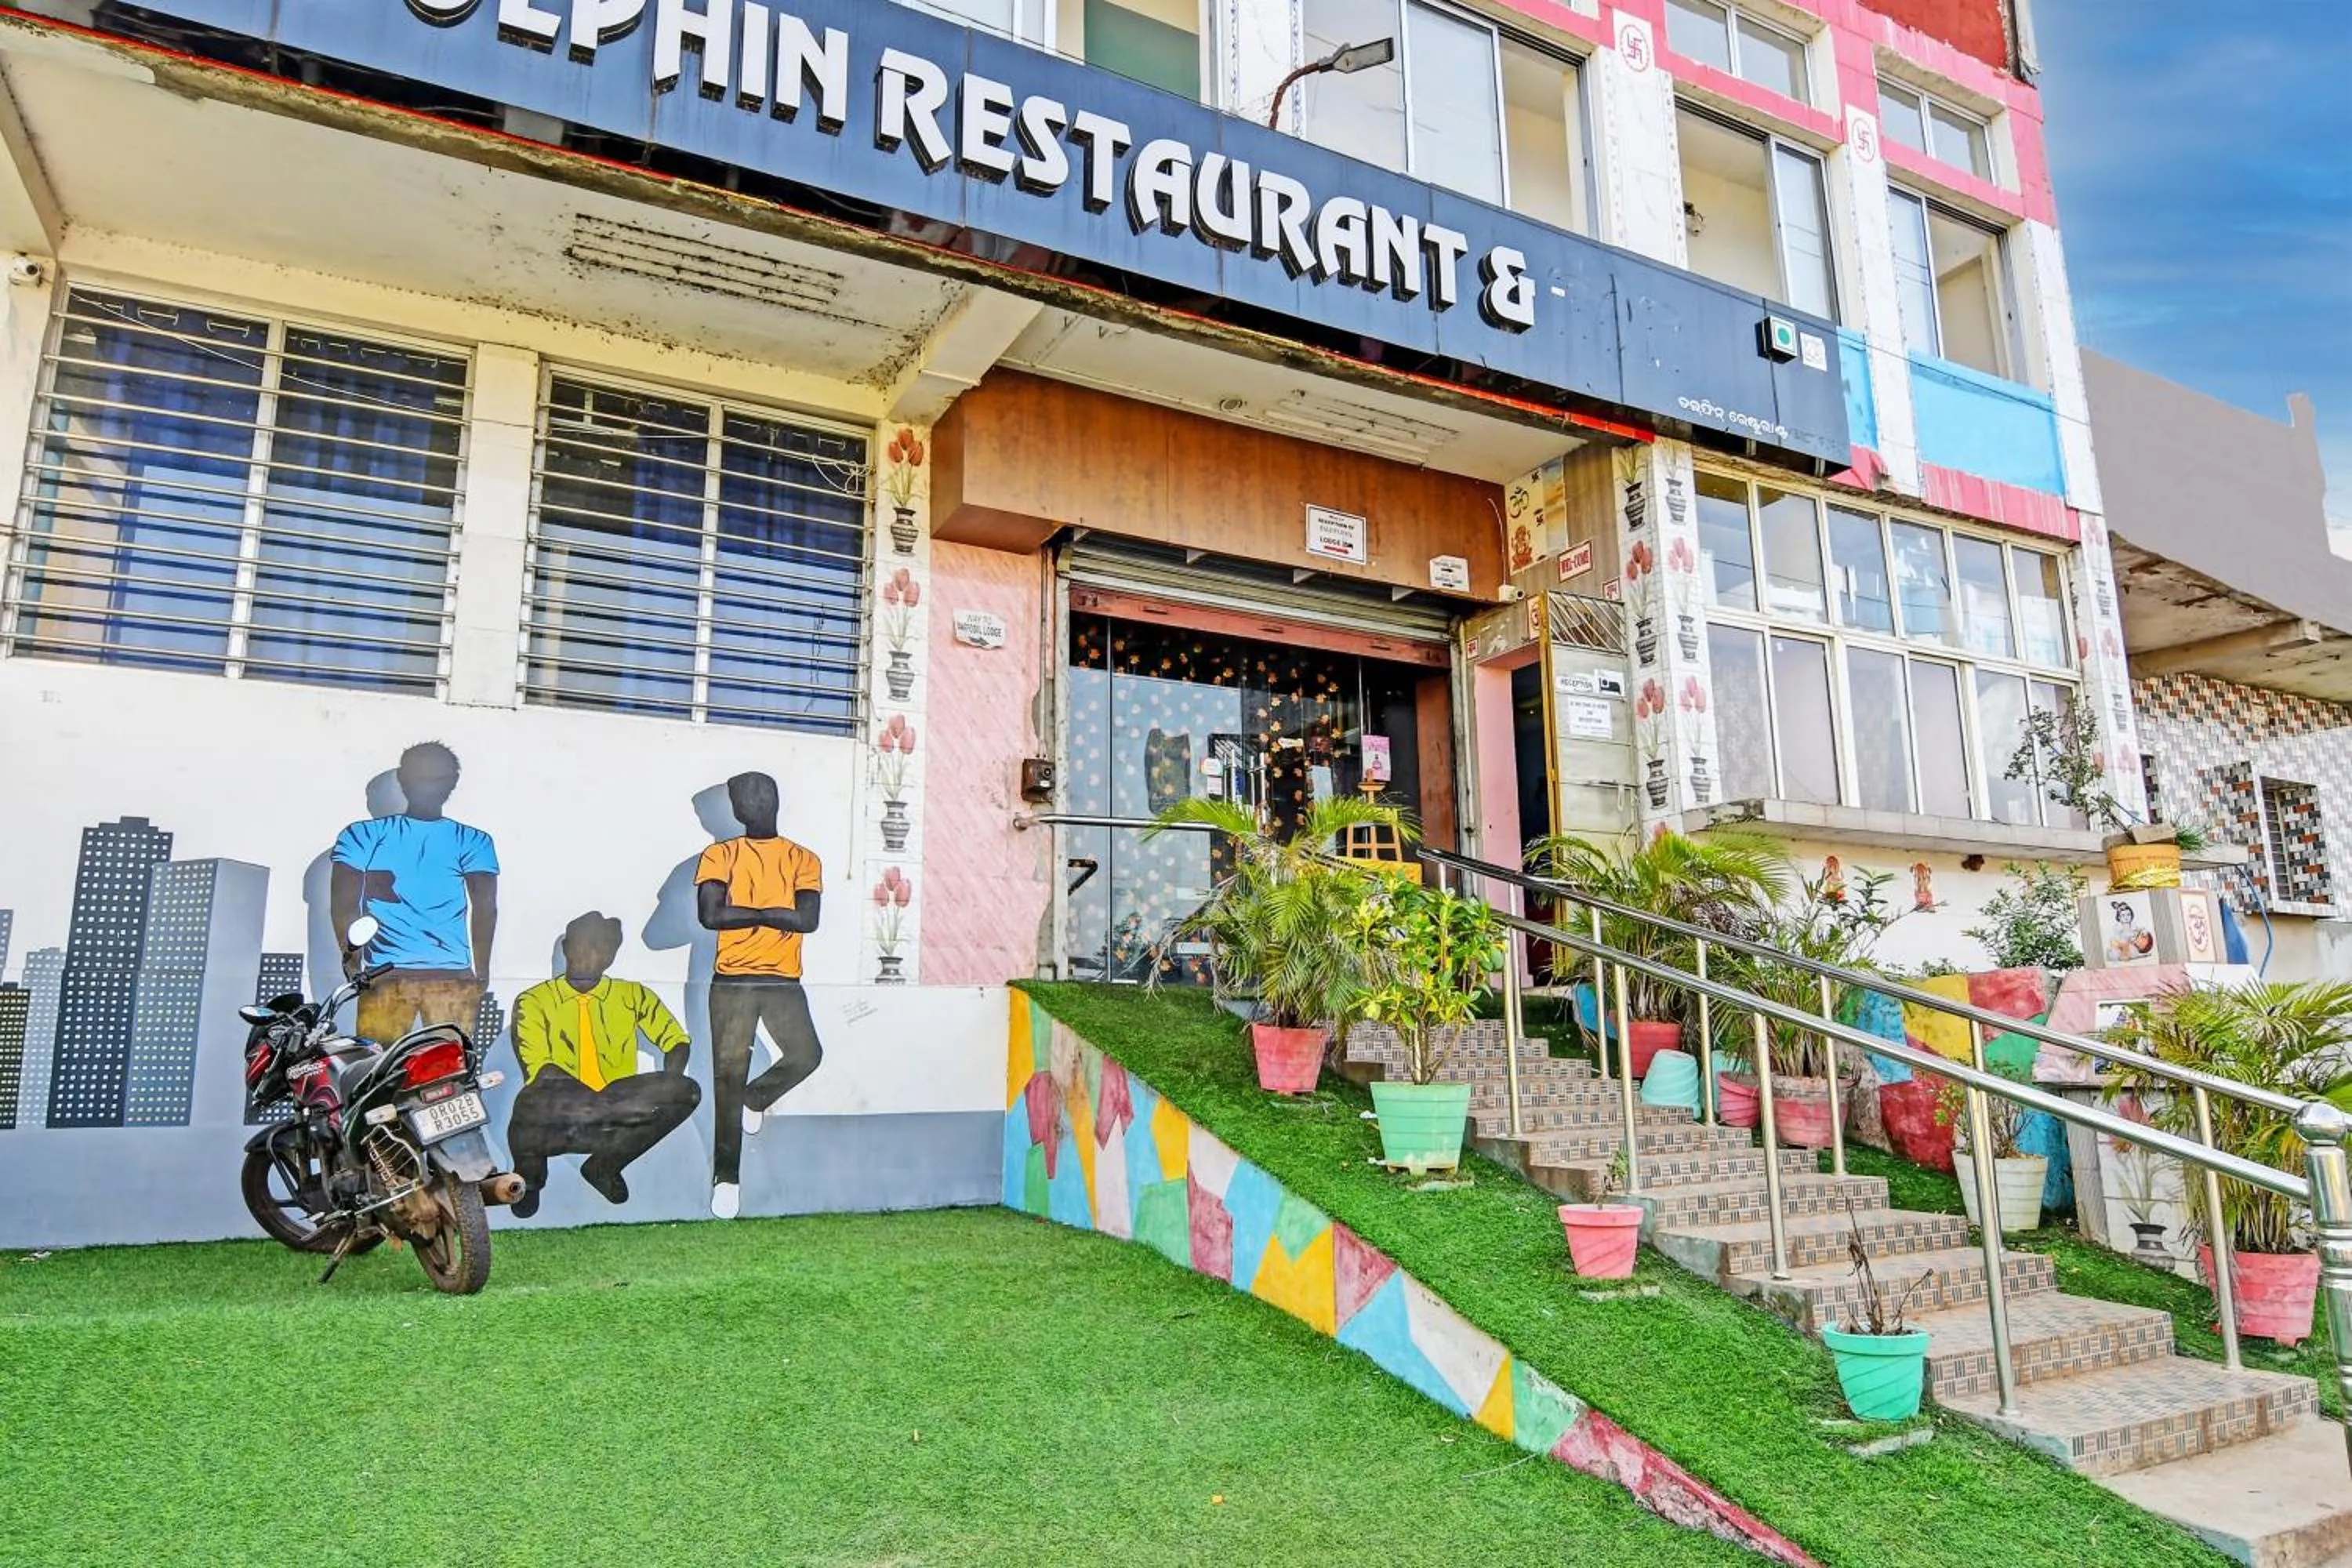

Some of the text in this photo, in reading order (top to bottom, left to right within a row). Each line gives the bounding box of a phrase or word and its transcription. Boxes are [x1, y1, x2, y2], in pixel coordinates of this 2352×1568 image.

[405, 0, 1536, 335] LPHIN RESTAURANT &
[434, 1106, 480, 1131] R3055
